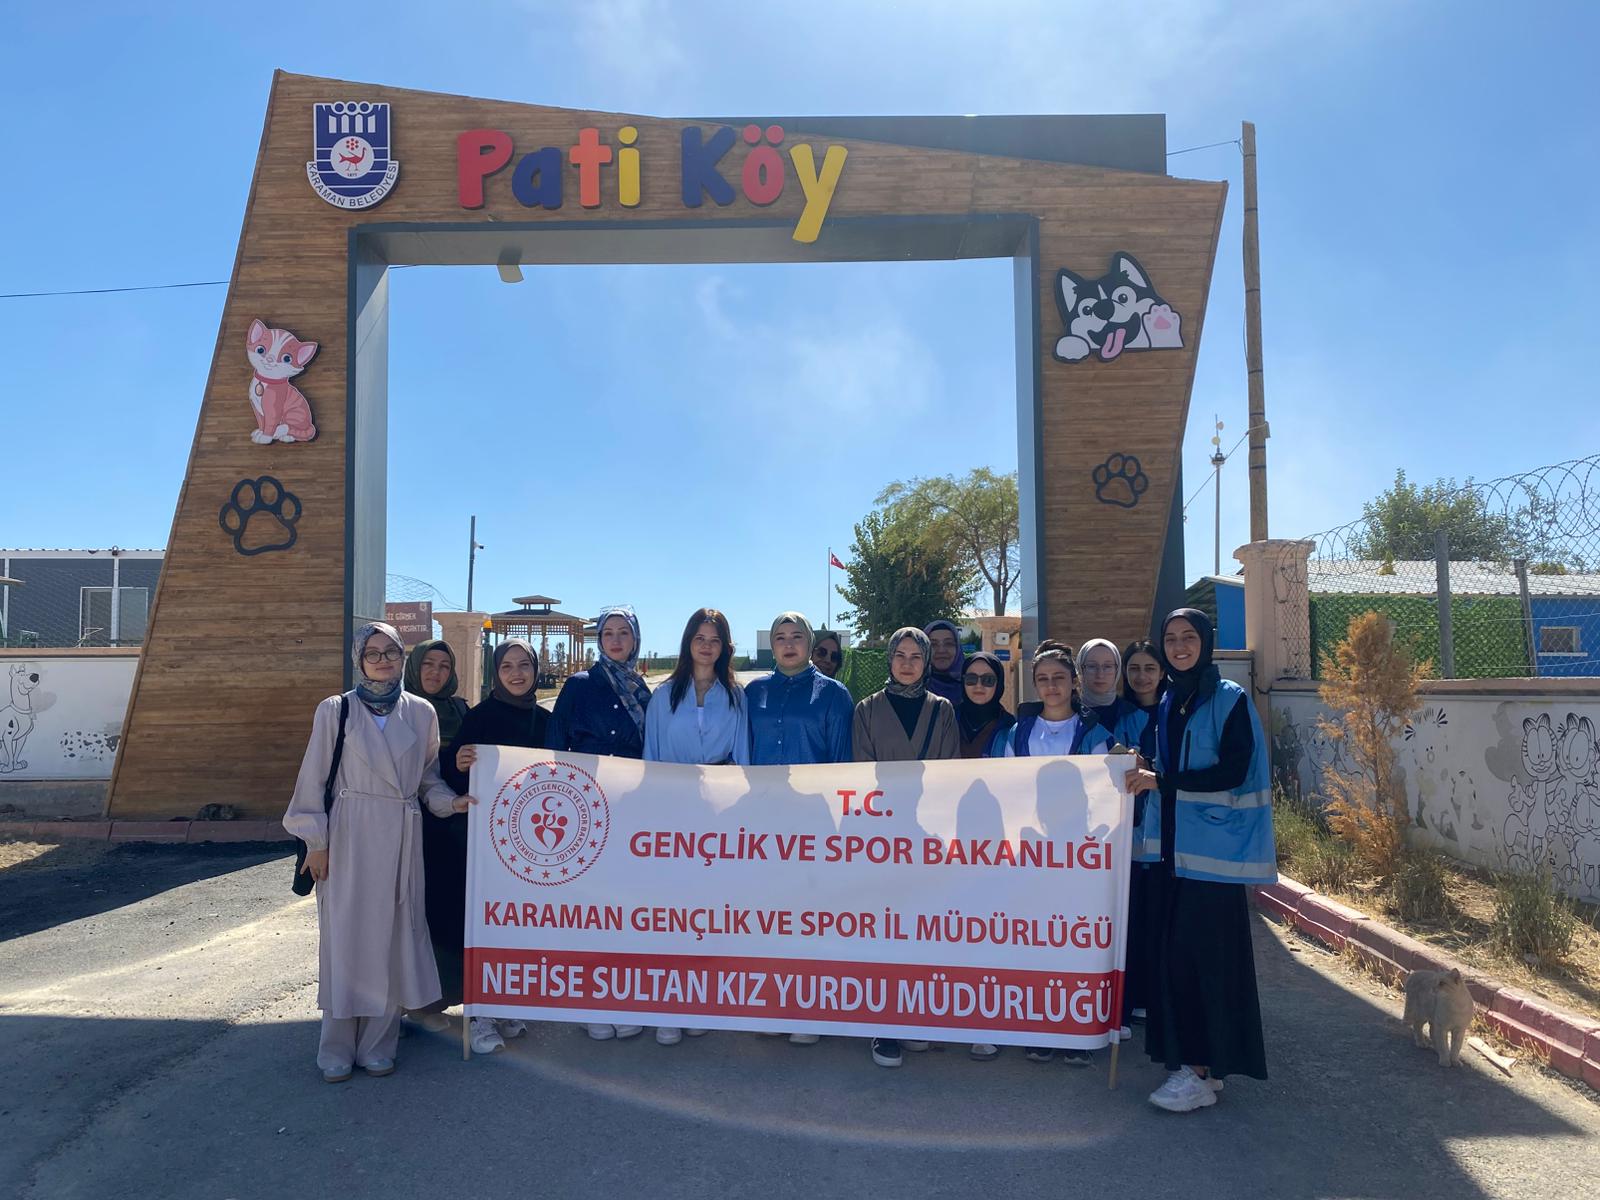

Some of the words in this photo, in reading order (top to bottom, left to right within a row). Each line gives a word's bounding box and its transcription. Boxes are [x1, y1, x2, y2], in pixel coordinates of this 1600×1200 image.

[309, 163, 345, 205] KARAMAN
[457, 126, 641, 208] Pati
[681, 125, 848, 243] Köy
[541, 783, 574, 796] GENÇLİK
[573, 793, 582, 803] VE
[837, 790, 893, 817] T.C.
[511, 787, 540, 834] CUMHURİYETİ
[579, 803, 587, 826] SPOR
[514, 834, 538, 861] TÜRKİYE
[556, 827, 587, 862] BAKANLIĞI
[629, 827, 768, 866] GENÇLİK
[775, 834, 816, 861] VE
[825, 836, 913, 864] SPOR
[923, 835, 1112, 870] BAKANLIĞI
[484, 901, 623, 931] KARAMAN
[630, 903, 751, 941] GENÇLİK
[756, 910, 793, 935] VE
[800, 911, 876, 939] SPOR
[884, 906, 908, 940] İL
[916, 909, 1112, 949] MÜDÜRLÜĞÜ
[482, 956, 584, 998] NEFİSE
[592, 966, 707, 1004] SULTAN
[717, 971, 767, 1007] KIZ
[774, 973, 887, 1013] YURDU
[897, 972, 1112, 1024] MÜDÜRLÜĞÜ
